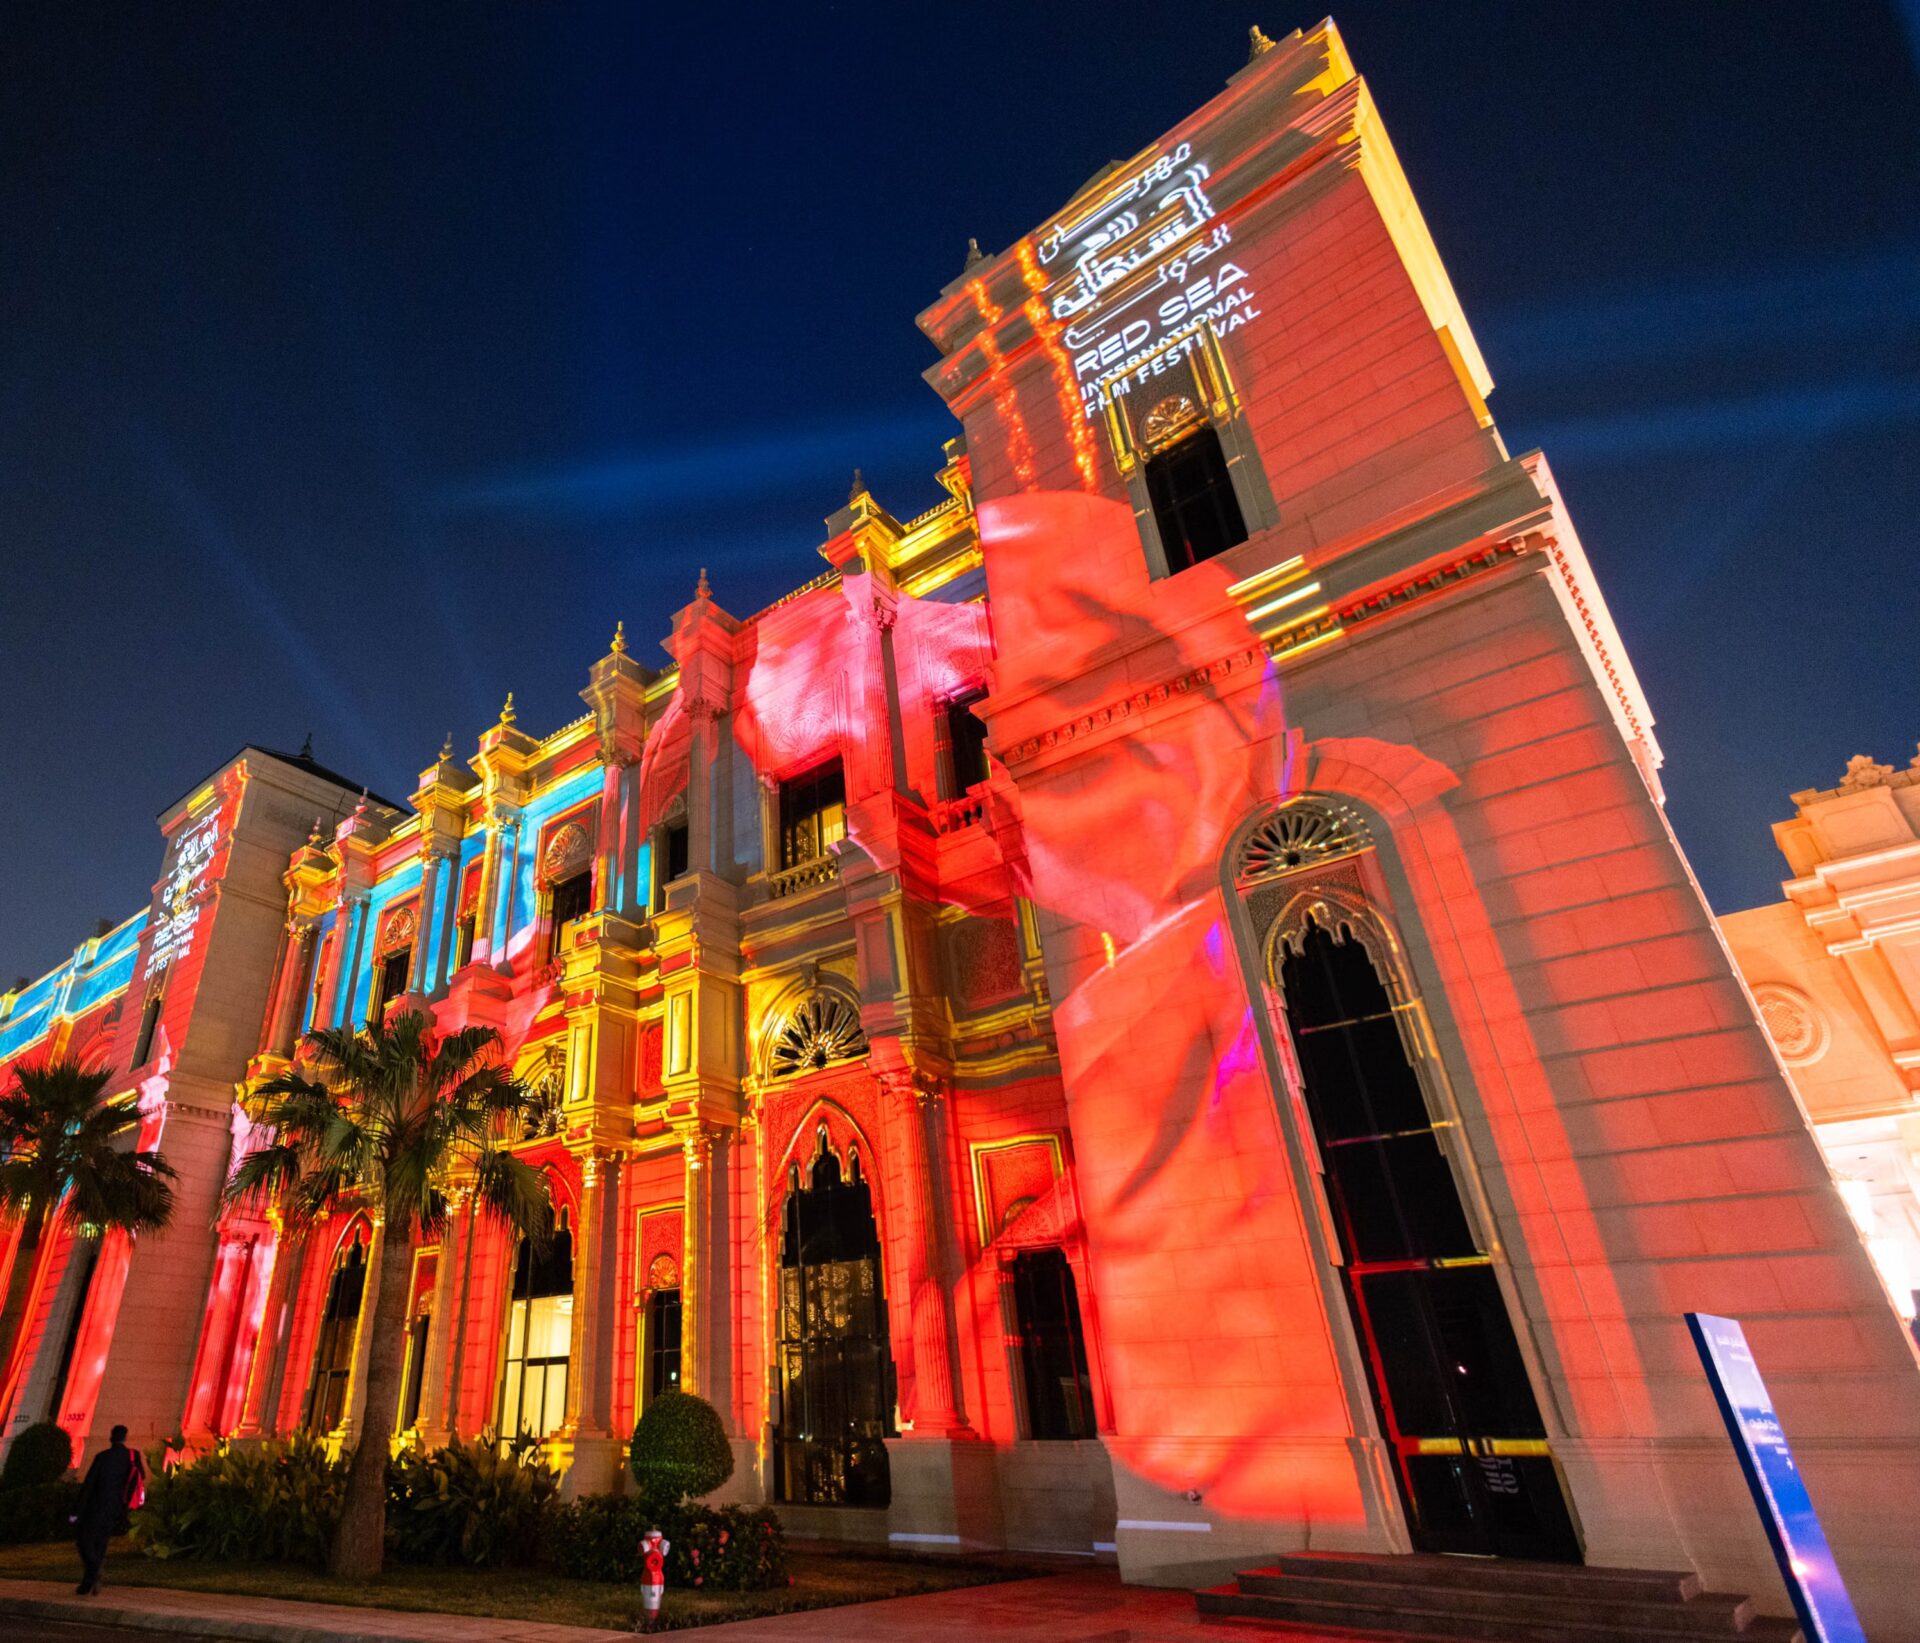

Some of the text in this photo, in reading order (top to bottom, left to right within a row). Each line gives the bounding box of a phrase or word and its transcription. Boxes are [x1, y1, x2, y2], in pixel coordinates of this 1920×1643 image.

[1073, 261, 1249, 382] RED SEA
[1080, 286, 1256, 401] INTERNATIONAL
[1136, 304, 1263, 385] FESTIVAL
[151, 905, 200, 951] RED SEA
